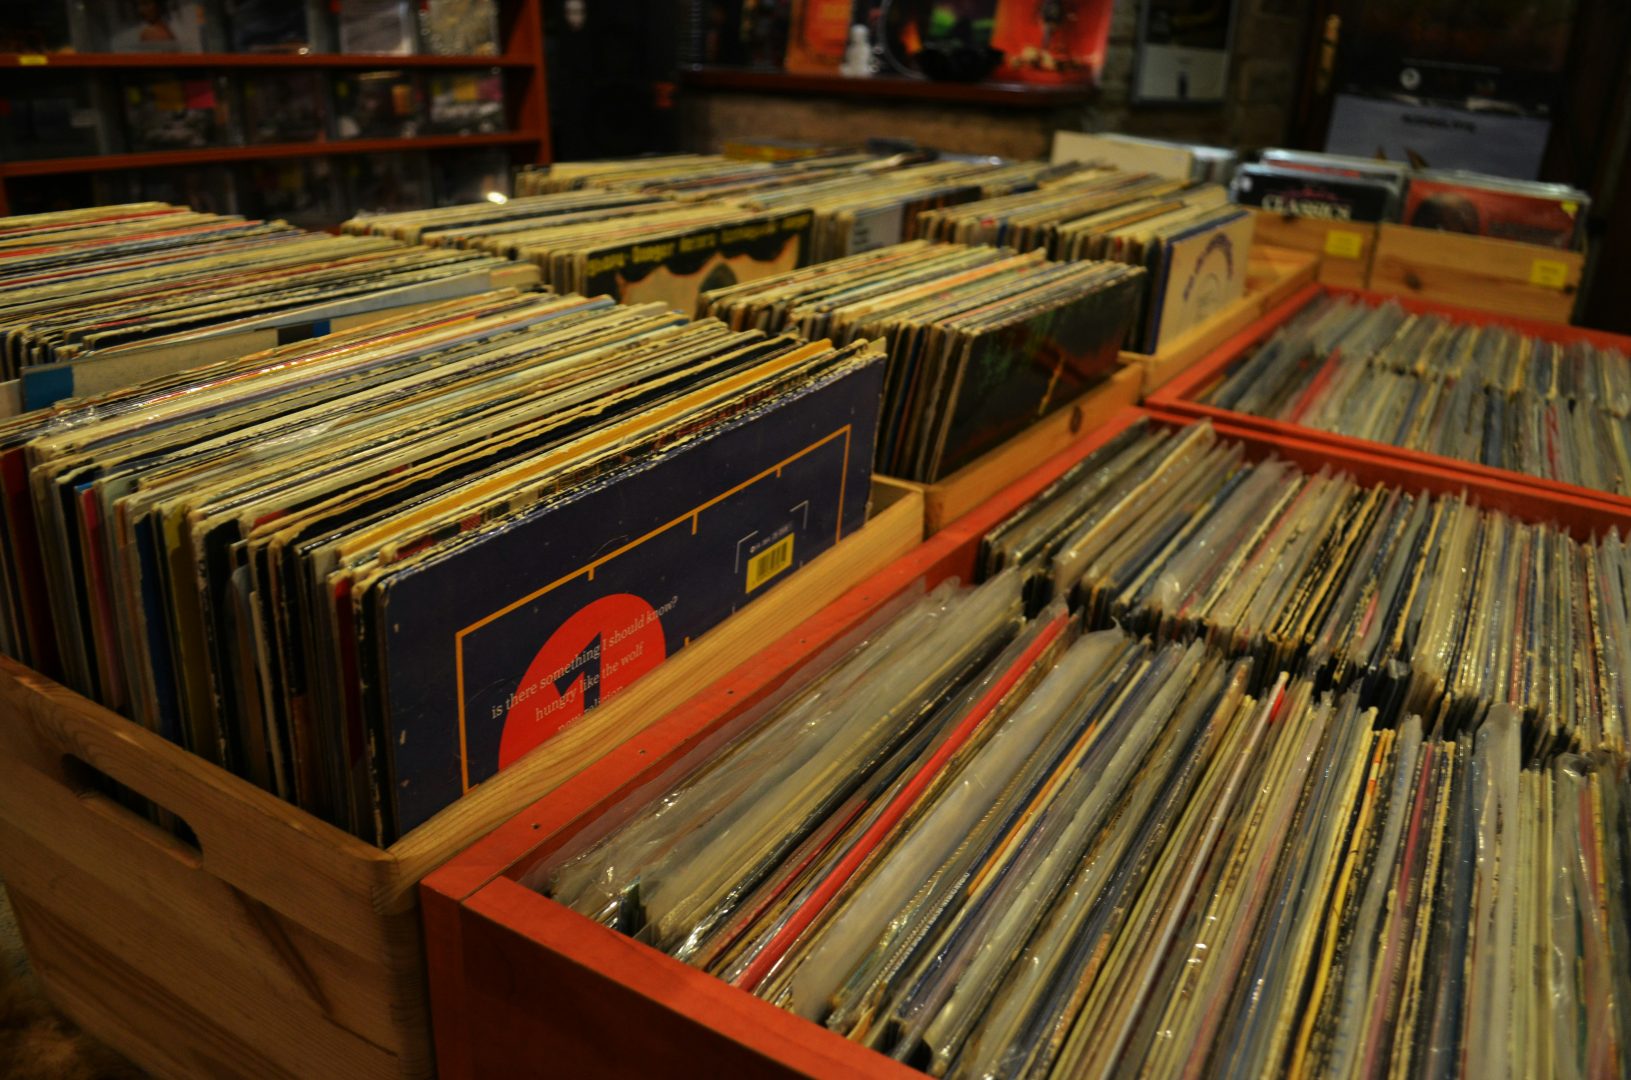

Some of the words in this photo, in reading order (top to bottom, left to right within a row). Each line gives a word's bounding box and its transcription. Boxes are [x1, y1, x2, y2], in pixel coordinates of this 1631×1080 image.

[491, 706, 503, 719] is
[505, 685, 538, 710] there
[540, 644, 601, 690] something
[603, 638, 607, 651] I
[609, 613, 645, 646] should
[646, 595, 679, 625] know?
[535, 687, 577, 722] hungry
[579, 672, 600, 694] like
[601, 660, 618, 679] the
[620, 641, 645, 666] wolf
